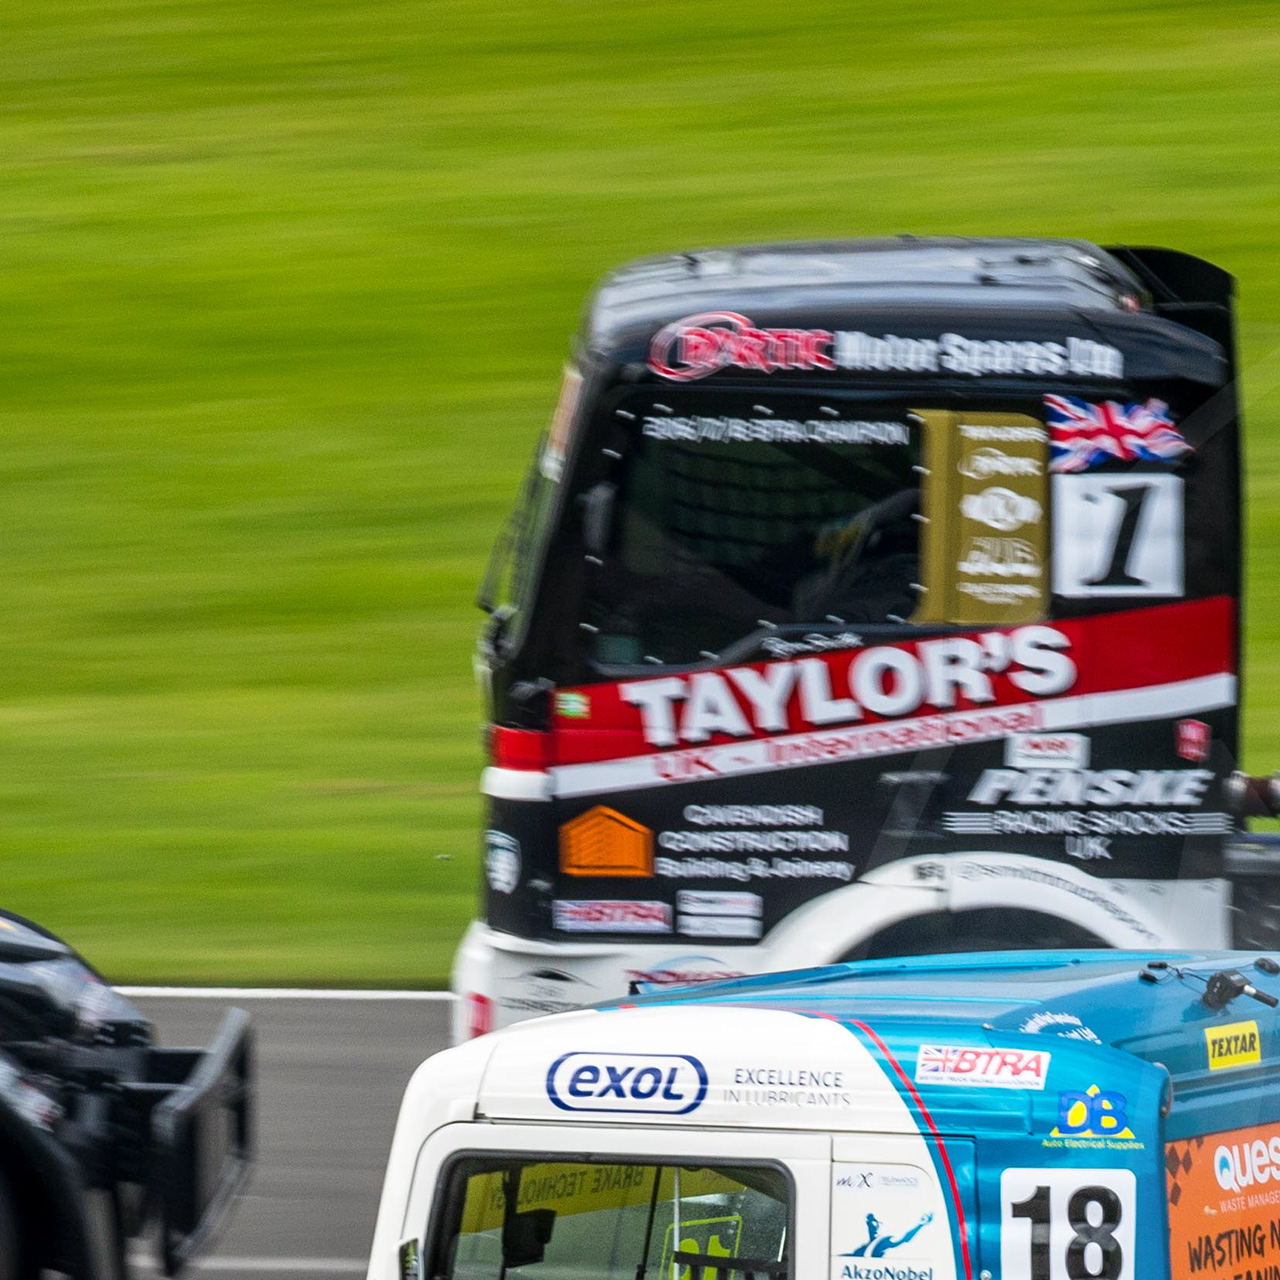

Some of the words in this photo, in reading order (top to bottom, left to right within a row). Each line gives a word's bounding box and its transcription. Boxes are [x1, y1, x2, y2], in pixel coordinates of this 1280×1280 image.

[835, 331, 939, 372] Motor
[940, 333, 1068, 376] Spares
[619, 625, 1077, 748] TAYLOR'S
[653, 748, 725, 783] UK
[767, 703, 1044, 764] International
[966, 769, 1216, 805] PENSKE
[683, 805, 824, 826] CAVENDISH
[658, 831, 849, 852] CONSTRUCTION
[1065, 835, 1112, 860] UK
[1211, 1031, 1257, 1057] TEXTAR
[953, 1049, 1041, 1077] BTRA
[568, 1062, 686, 1101] exol
[735, 1068, 842, 1087] EXCELLENCE
[724, 1089, 740, 1104] IN
[743, 1090, 850, 1109] LUBRICANTS
[1058, 1090, 1128, 1135] DB
[1042, 1138, 1063, 1148] Auto
[1065, 1139, 1105, 1149] Electrical
[1107, 1141, 1145, 1151] Supplies
[1219, 1194, 1247, 1214] WASTE
[1188, 1224, 1266, 1272] WASTING
